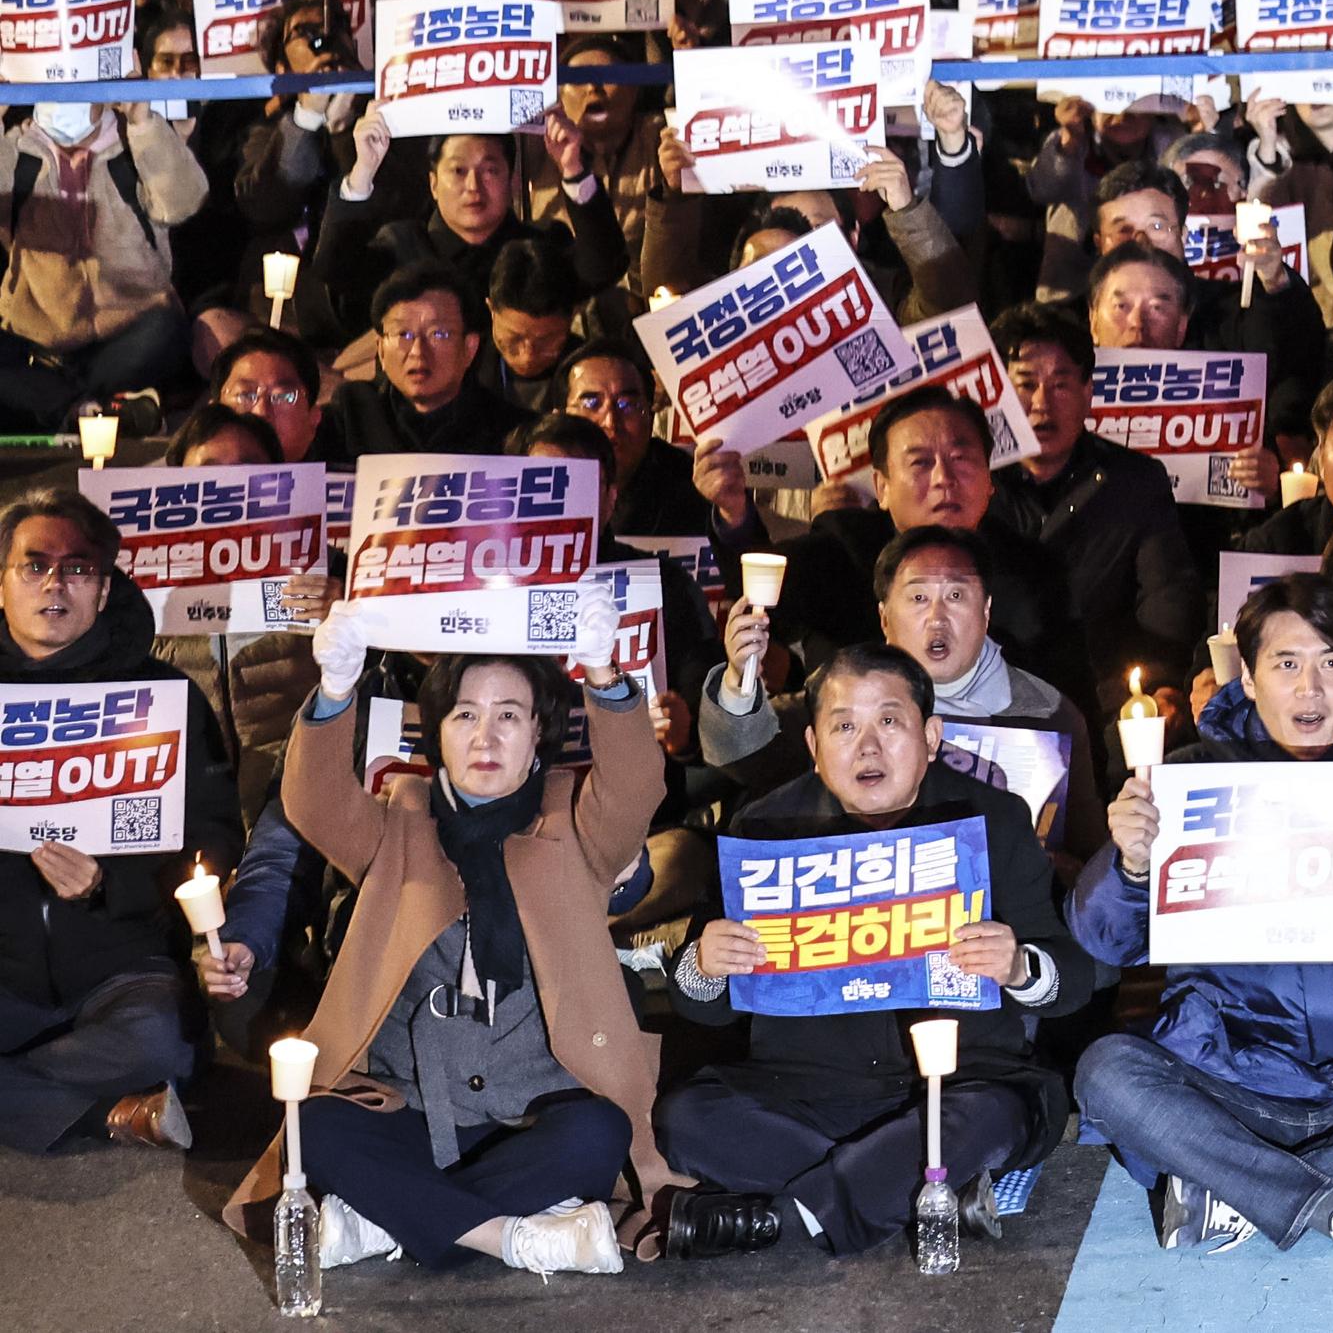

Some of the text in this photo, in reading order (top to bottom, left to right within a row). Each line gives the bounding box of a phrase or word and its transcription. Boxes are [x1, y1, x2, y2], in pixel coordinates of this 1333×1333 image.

[65, 2, 128, 45] OUT!
[407, 3, 535, 47] 국정농단
[381, 49, 548, 98] 윤석열 OUT!
[447, 105, 484, 121] 민주당
[688, 106, 780, 154] 윤석열
[765, 164, 803, 179] 민주당
[665, 243, 826, 366] 국정농단
[677, 348, 776, 418] 윤석열
[778, 275, 868, 362] OUT!
[779, 387, 823, 420] 민주당
[1164, 406, 1256, 447] OUT!
[108, 470, 296, 532] 국정농단
[374, 467, 570, 524] 국정농단
[208, 526, 313, 574] OUT!
[354, 529, 586, 586] 윤석열 OUT!
[186, 604, 232, 622] 민주당
[439, 616, 491, 635] 민주당
[57, 742, 172, 795] OUT!
[29, 824, 78, 842] 민주당
[738, 836, 959, 911] 김건희를
[743, 889, 985, 969] 특검하라!
[840, 980, 890, 1002] 민주당
